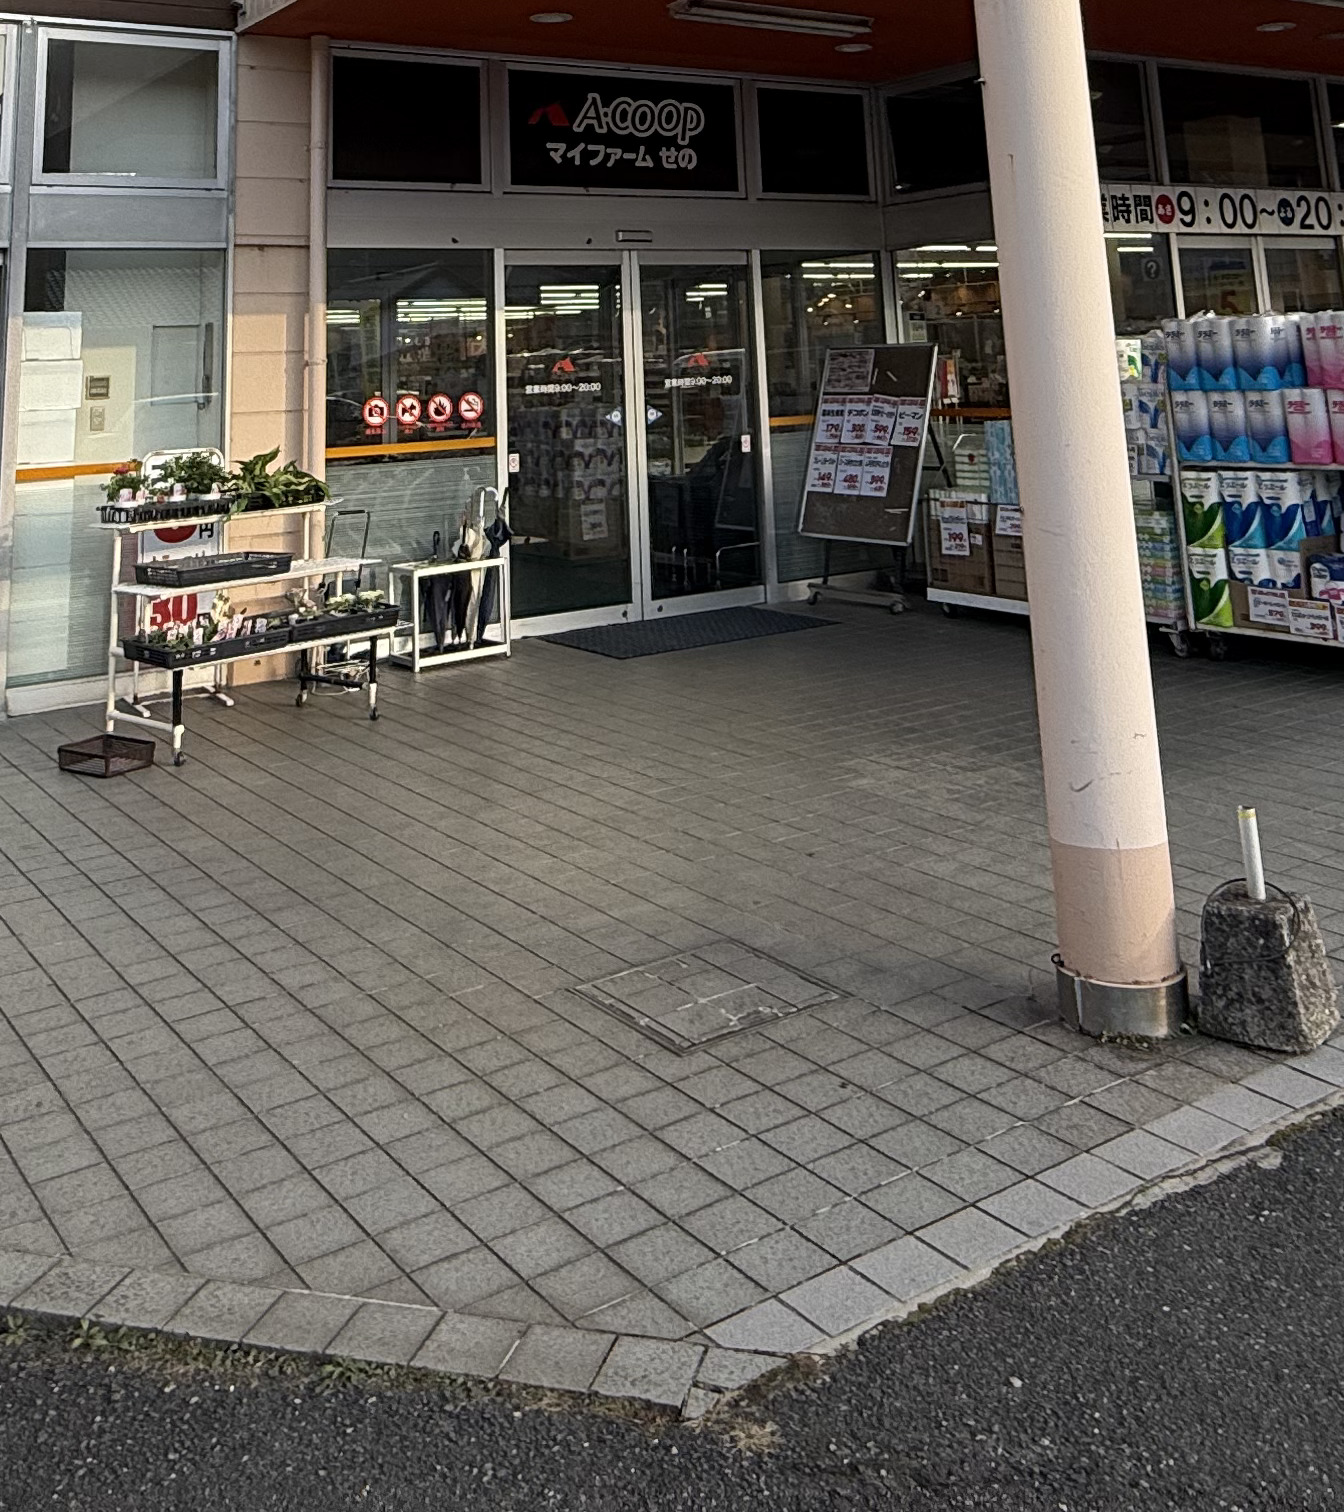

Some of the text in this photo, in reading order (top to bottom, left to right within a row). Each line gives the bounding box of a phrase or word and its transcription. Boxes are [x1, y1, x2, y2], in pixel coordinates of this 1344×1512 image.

[545, 142, 698, 170] マイファーム せの
